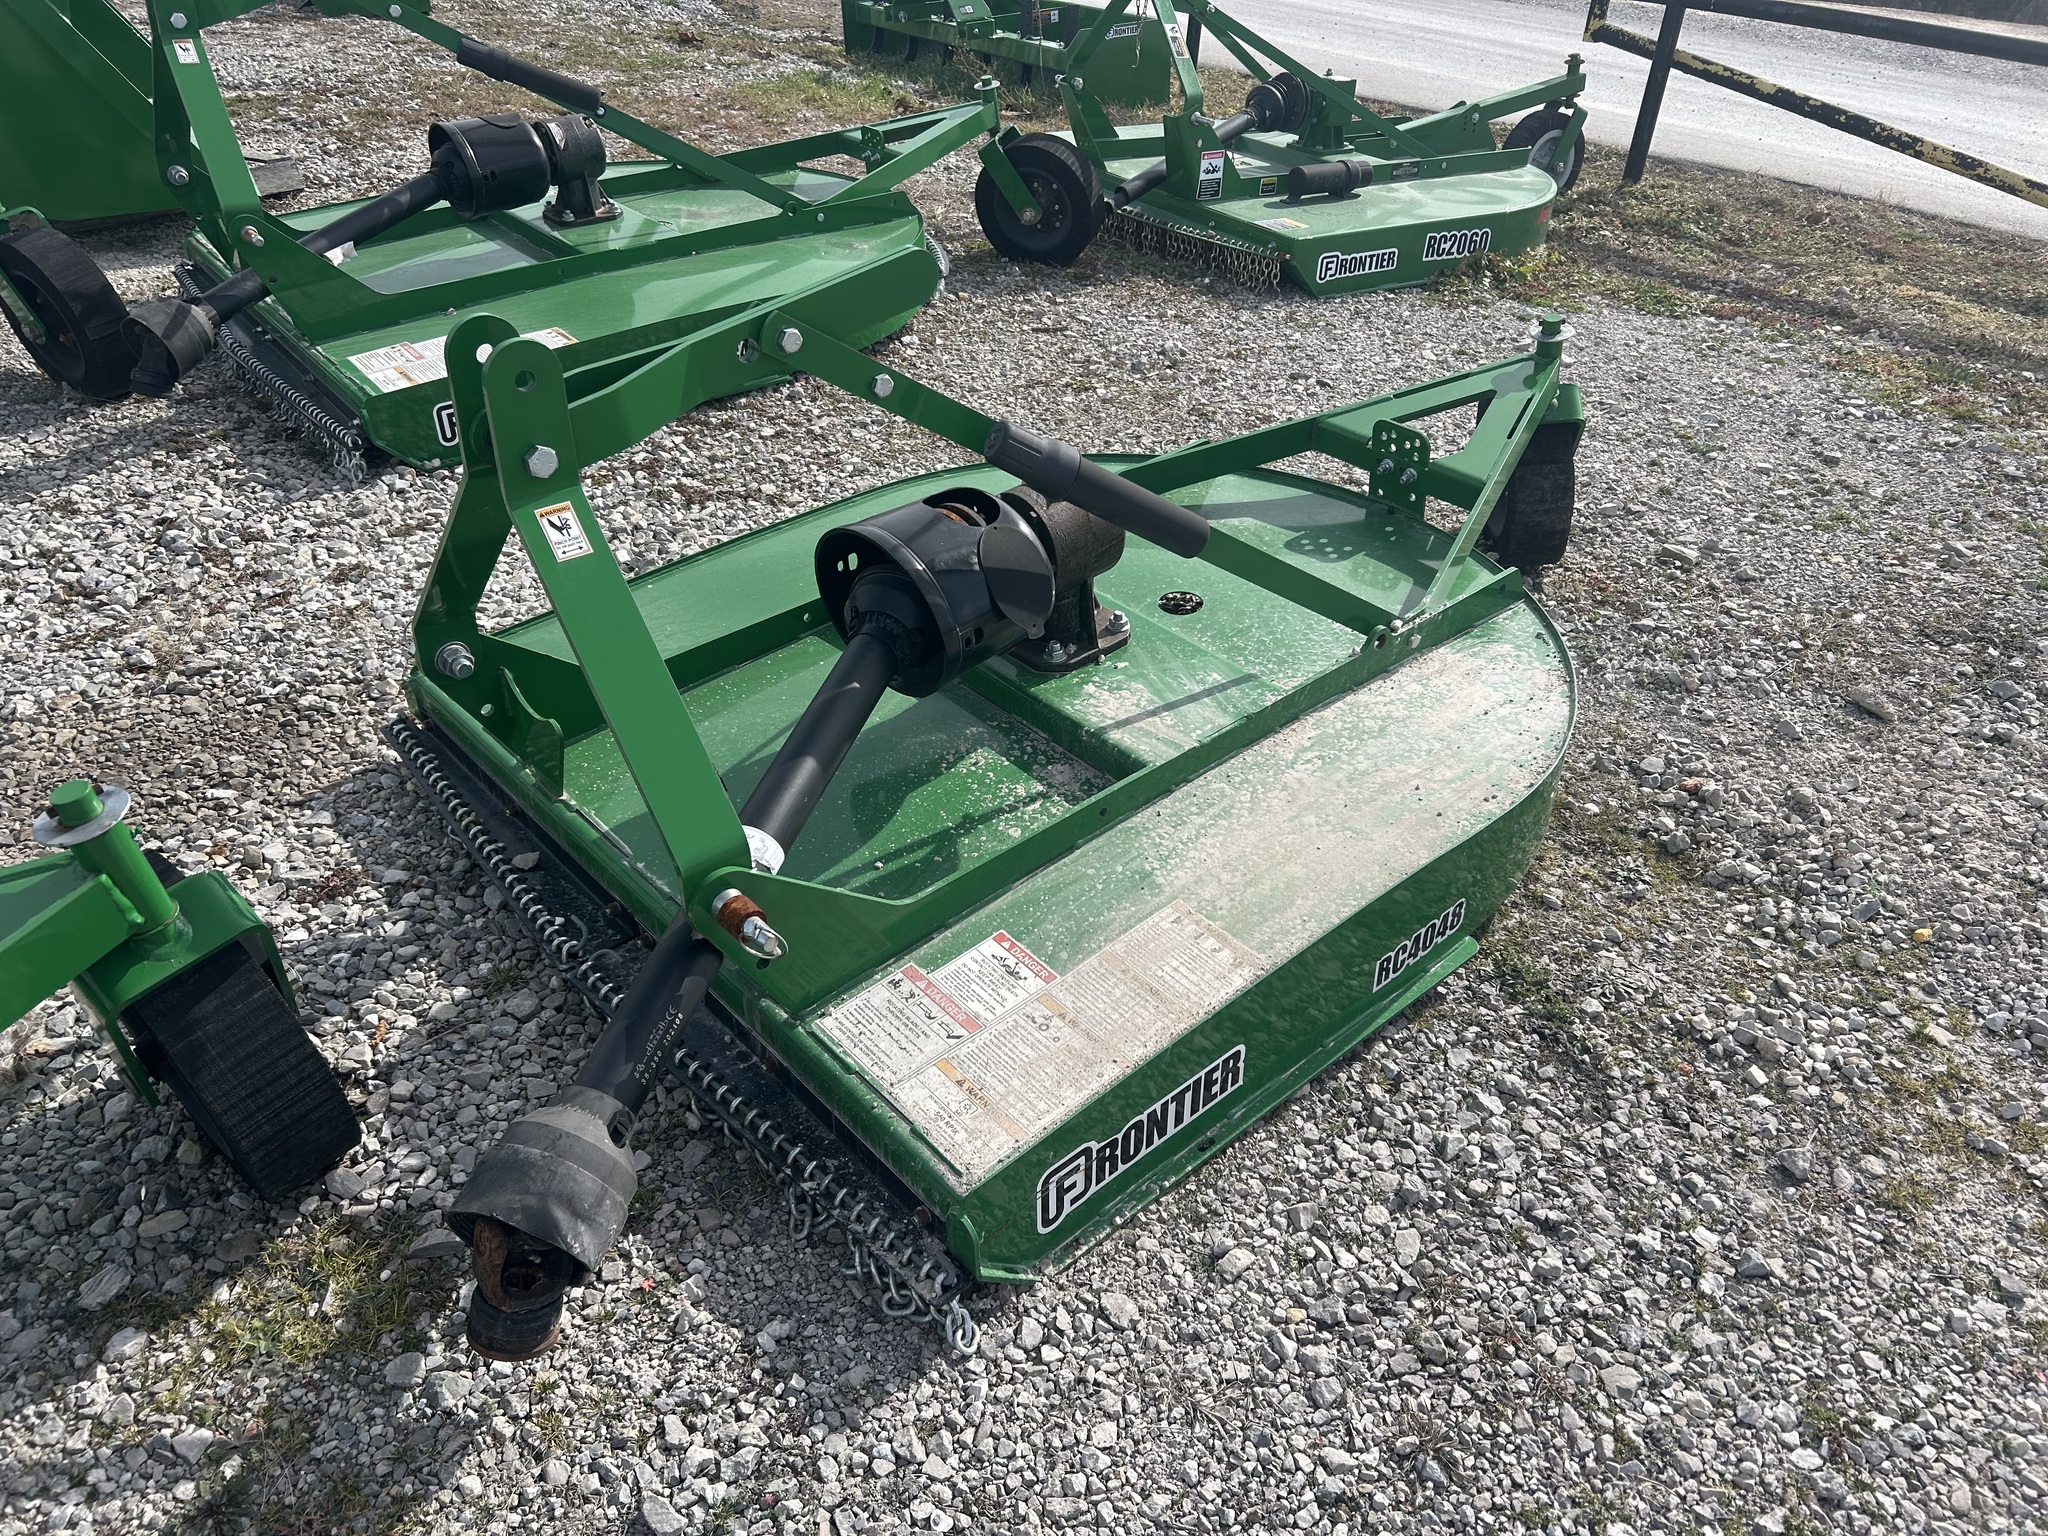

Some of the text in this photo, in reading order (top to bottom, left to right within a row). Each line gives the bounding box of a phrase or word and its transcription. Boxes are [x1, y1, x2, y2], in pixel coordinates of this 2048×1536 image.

[1424, 230, 1490, 259] RC2060
[1317, 250, 1397, 282] FRONTIER
[543, 505, 570, 516] WARNING
[1374, 899, 1465, 988] RC4048
[1008, 946, 1050, 979] DANGER
[925, 986, 968, 1022] DANGER
[1040, 1049, 1241, 1230] FRONTIER
